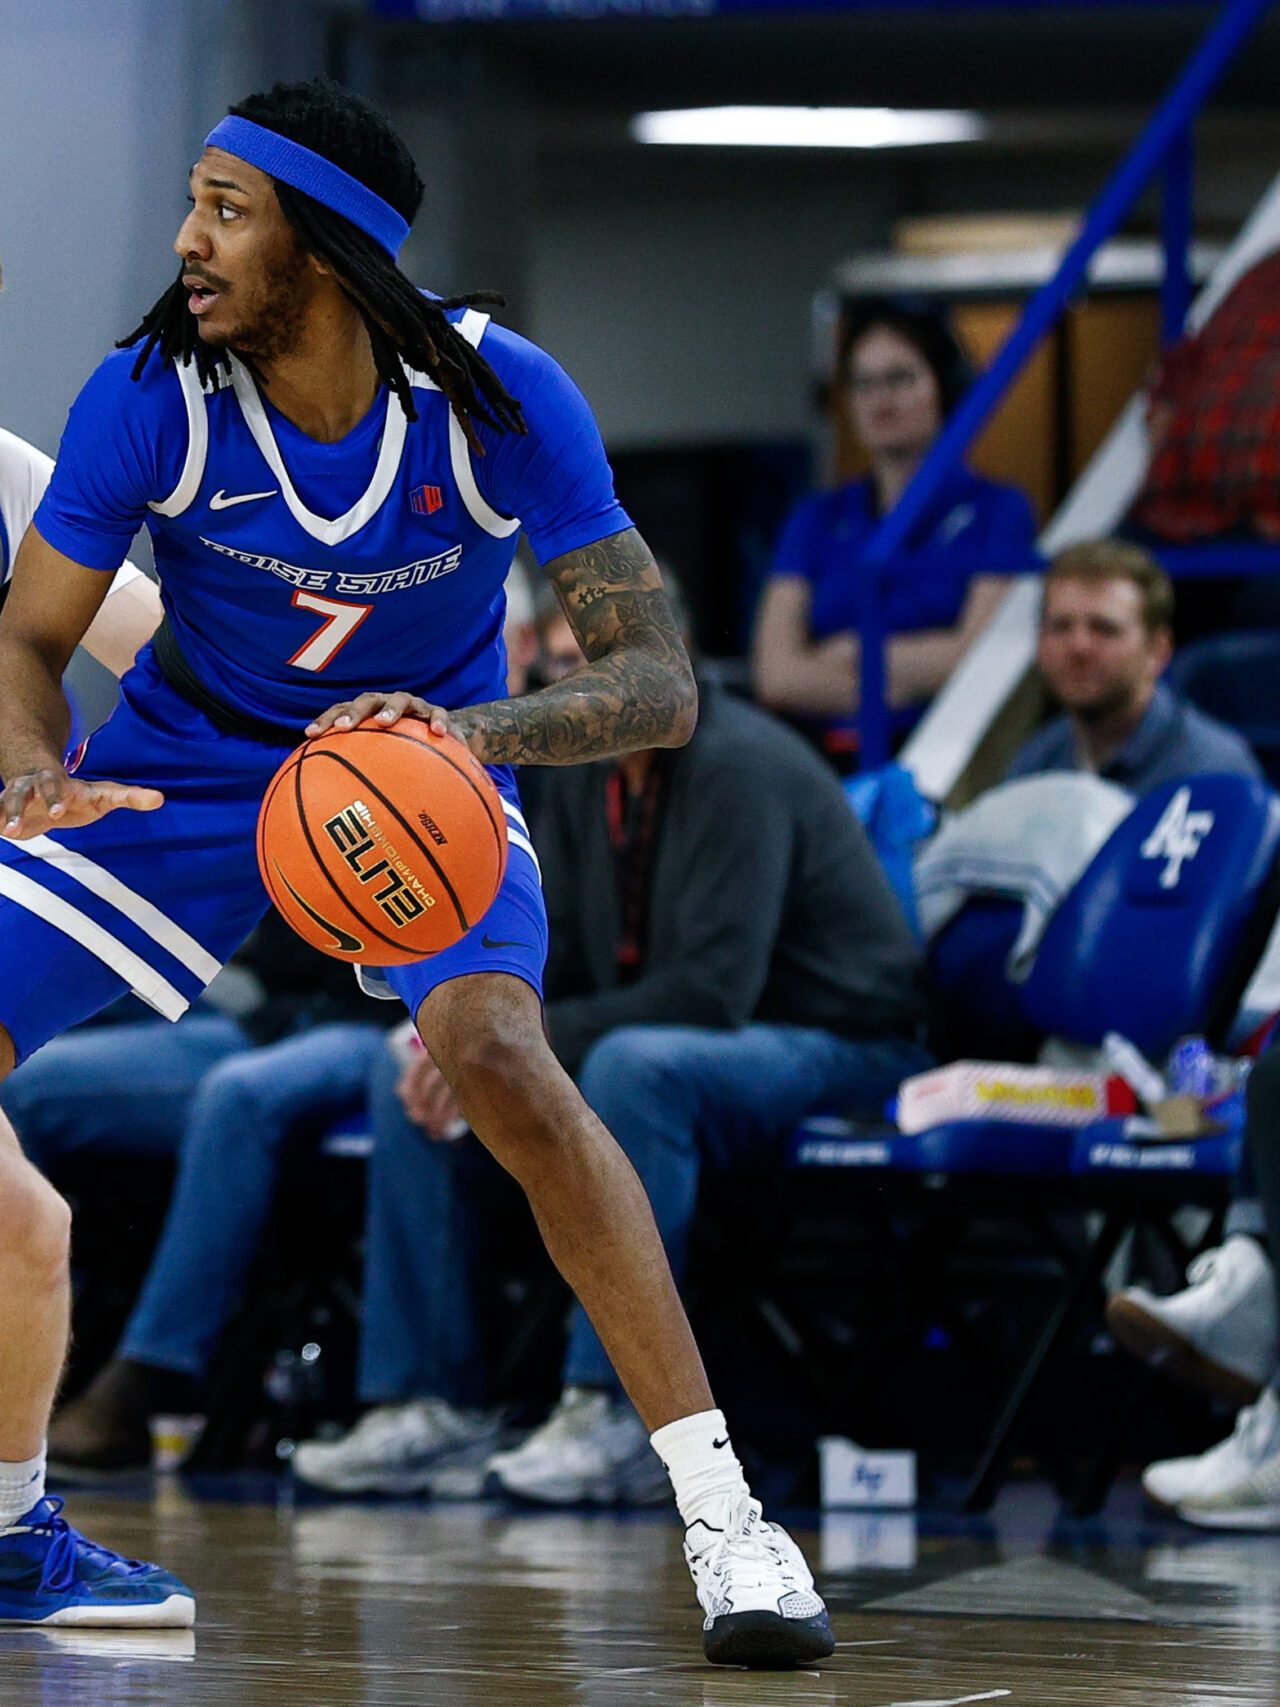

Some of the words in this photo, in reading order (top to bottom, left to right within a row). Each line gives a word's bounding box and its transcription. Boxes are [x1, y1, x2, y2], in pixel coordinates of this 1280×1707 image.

[336, 544, 462, 594] STATE
[285, 589, 375, 673] 7
[322, 804, 427, 928] ELITE
